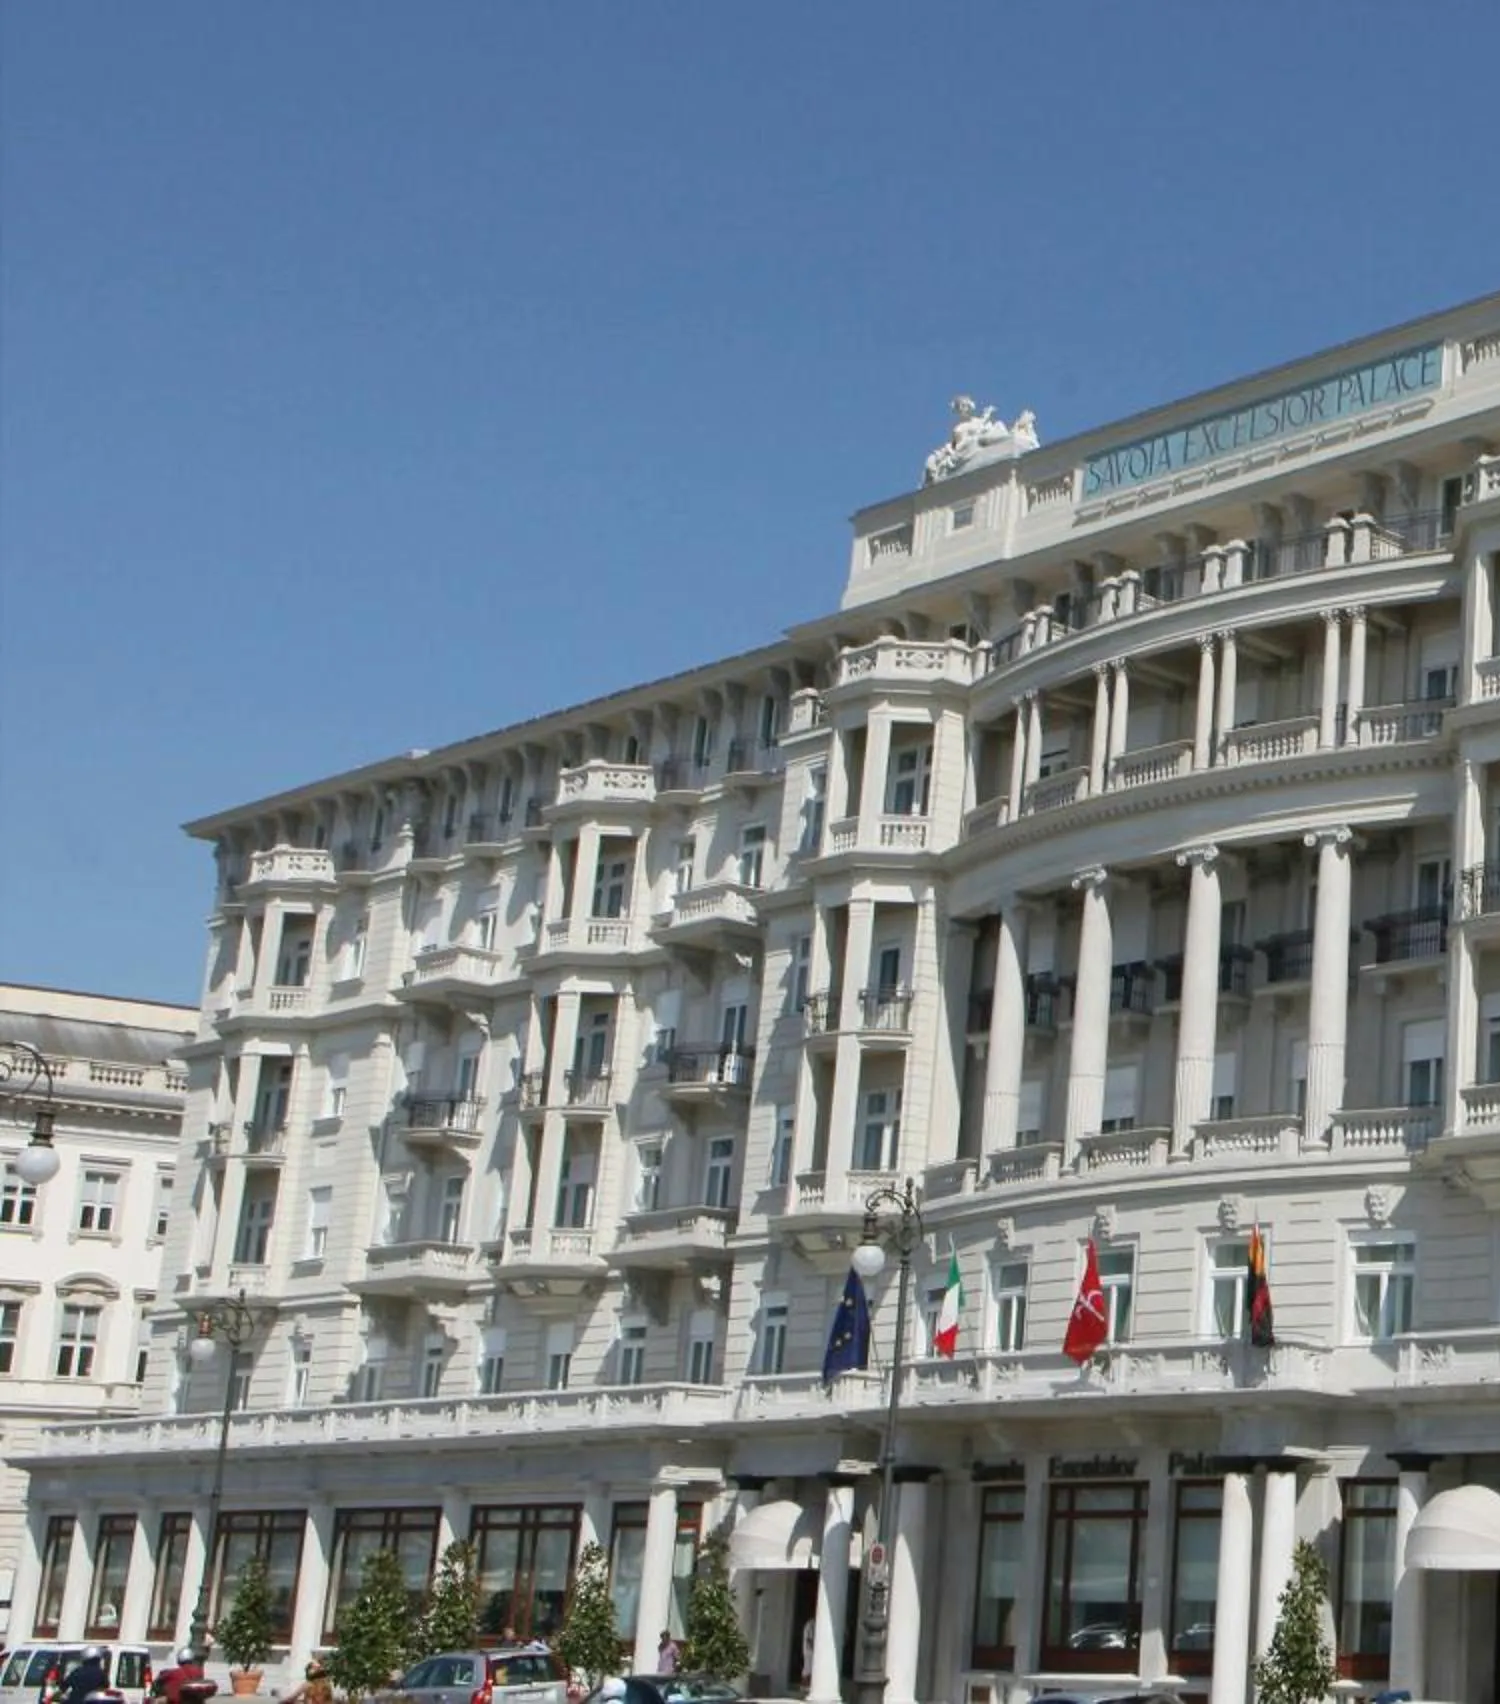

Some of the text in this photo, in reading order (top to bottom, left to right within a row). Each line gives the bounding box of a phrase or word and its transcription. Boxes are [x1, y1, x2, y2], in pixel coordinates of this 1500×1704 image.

[1086, 350, 1437, 494] SAVOIA EXCELSIOR PALACE
